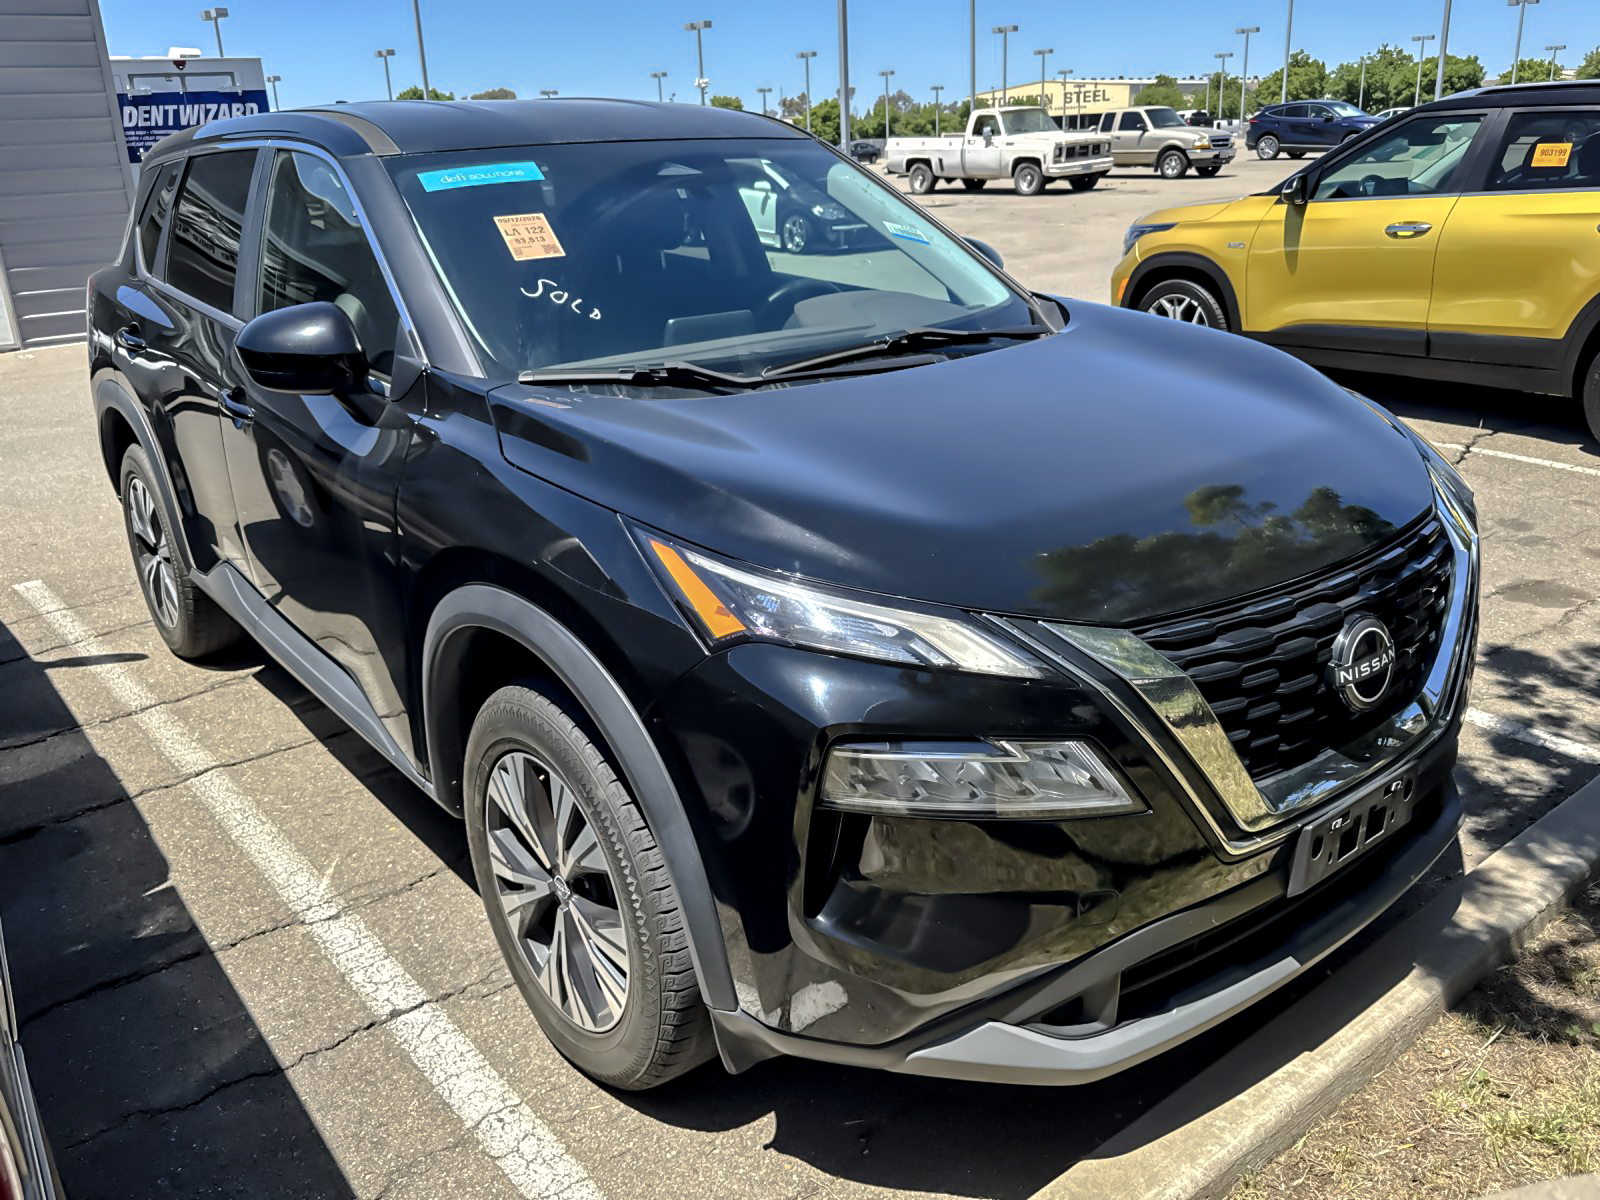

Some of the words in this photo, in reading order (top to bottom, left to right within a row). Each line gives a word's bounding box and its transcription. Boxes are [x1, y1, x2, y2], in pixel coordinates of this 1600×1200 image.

[1064, 89, 1110, 104] STEEL
[123, 104, 178, 127] DENT
[525, 226, 546, 235] 122
[520, 278, 602, 320] SOLD
[1340, 649, 1395, 683] NISSAN
